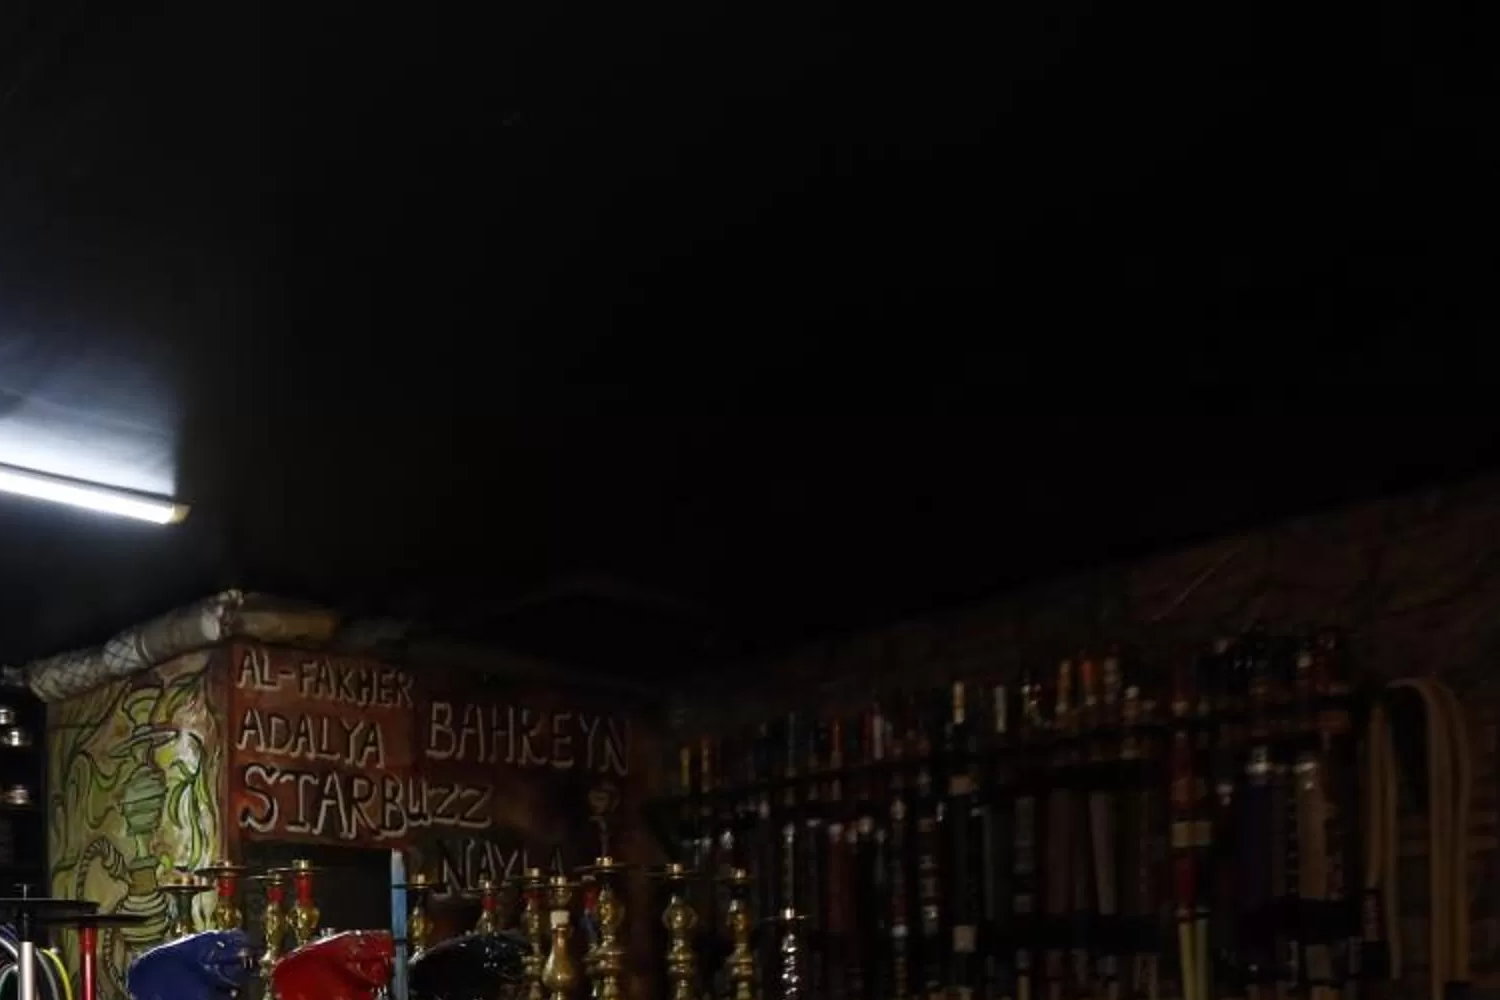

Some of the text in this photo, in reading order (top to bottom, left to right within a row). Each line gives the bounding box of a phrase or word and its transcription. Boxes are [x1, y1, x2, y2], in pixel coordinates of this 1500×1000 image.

[235, 646, 414, 709] AL-FAKHER
[235, 708, 386, 769] ADALYA
[424, 701, 630, 777] BAHREYN
